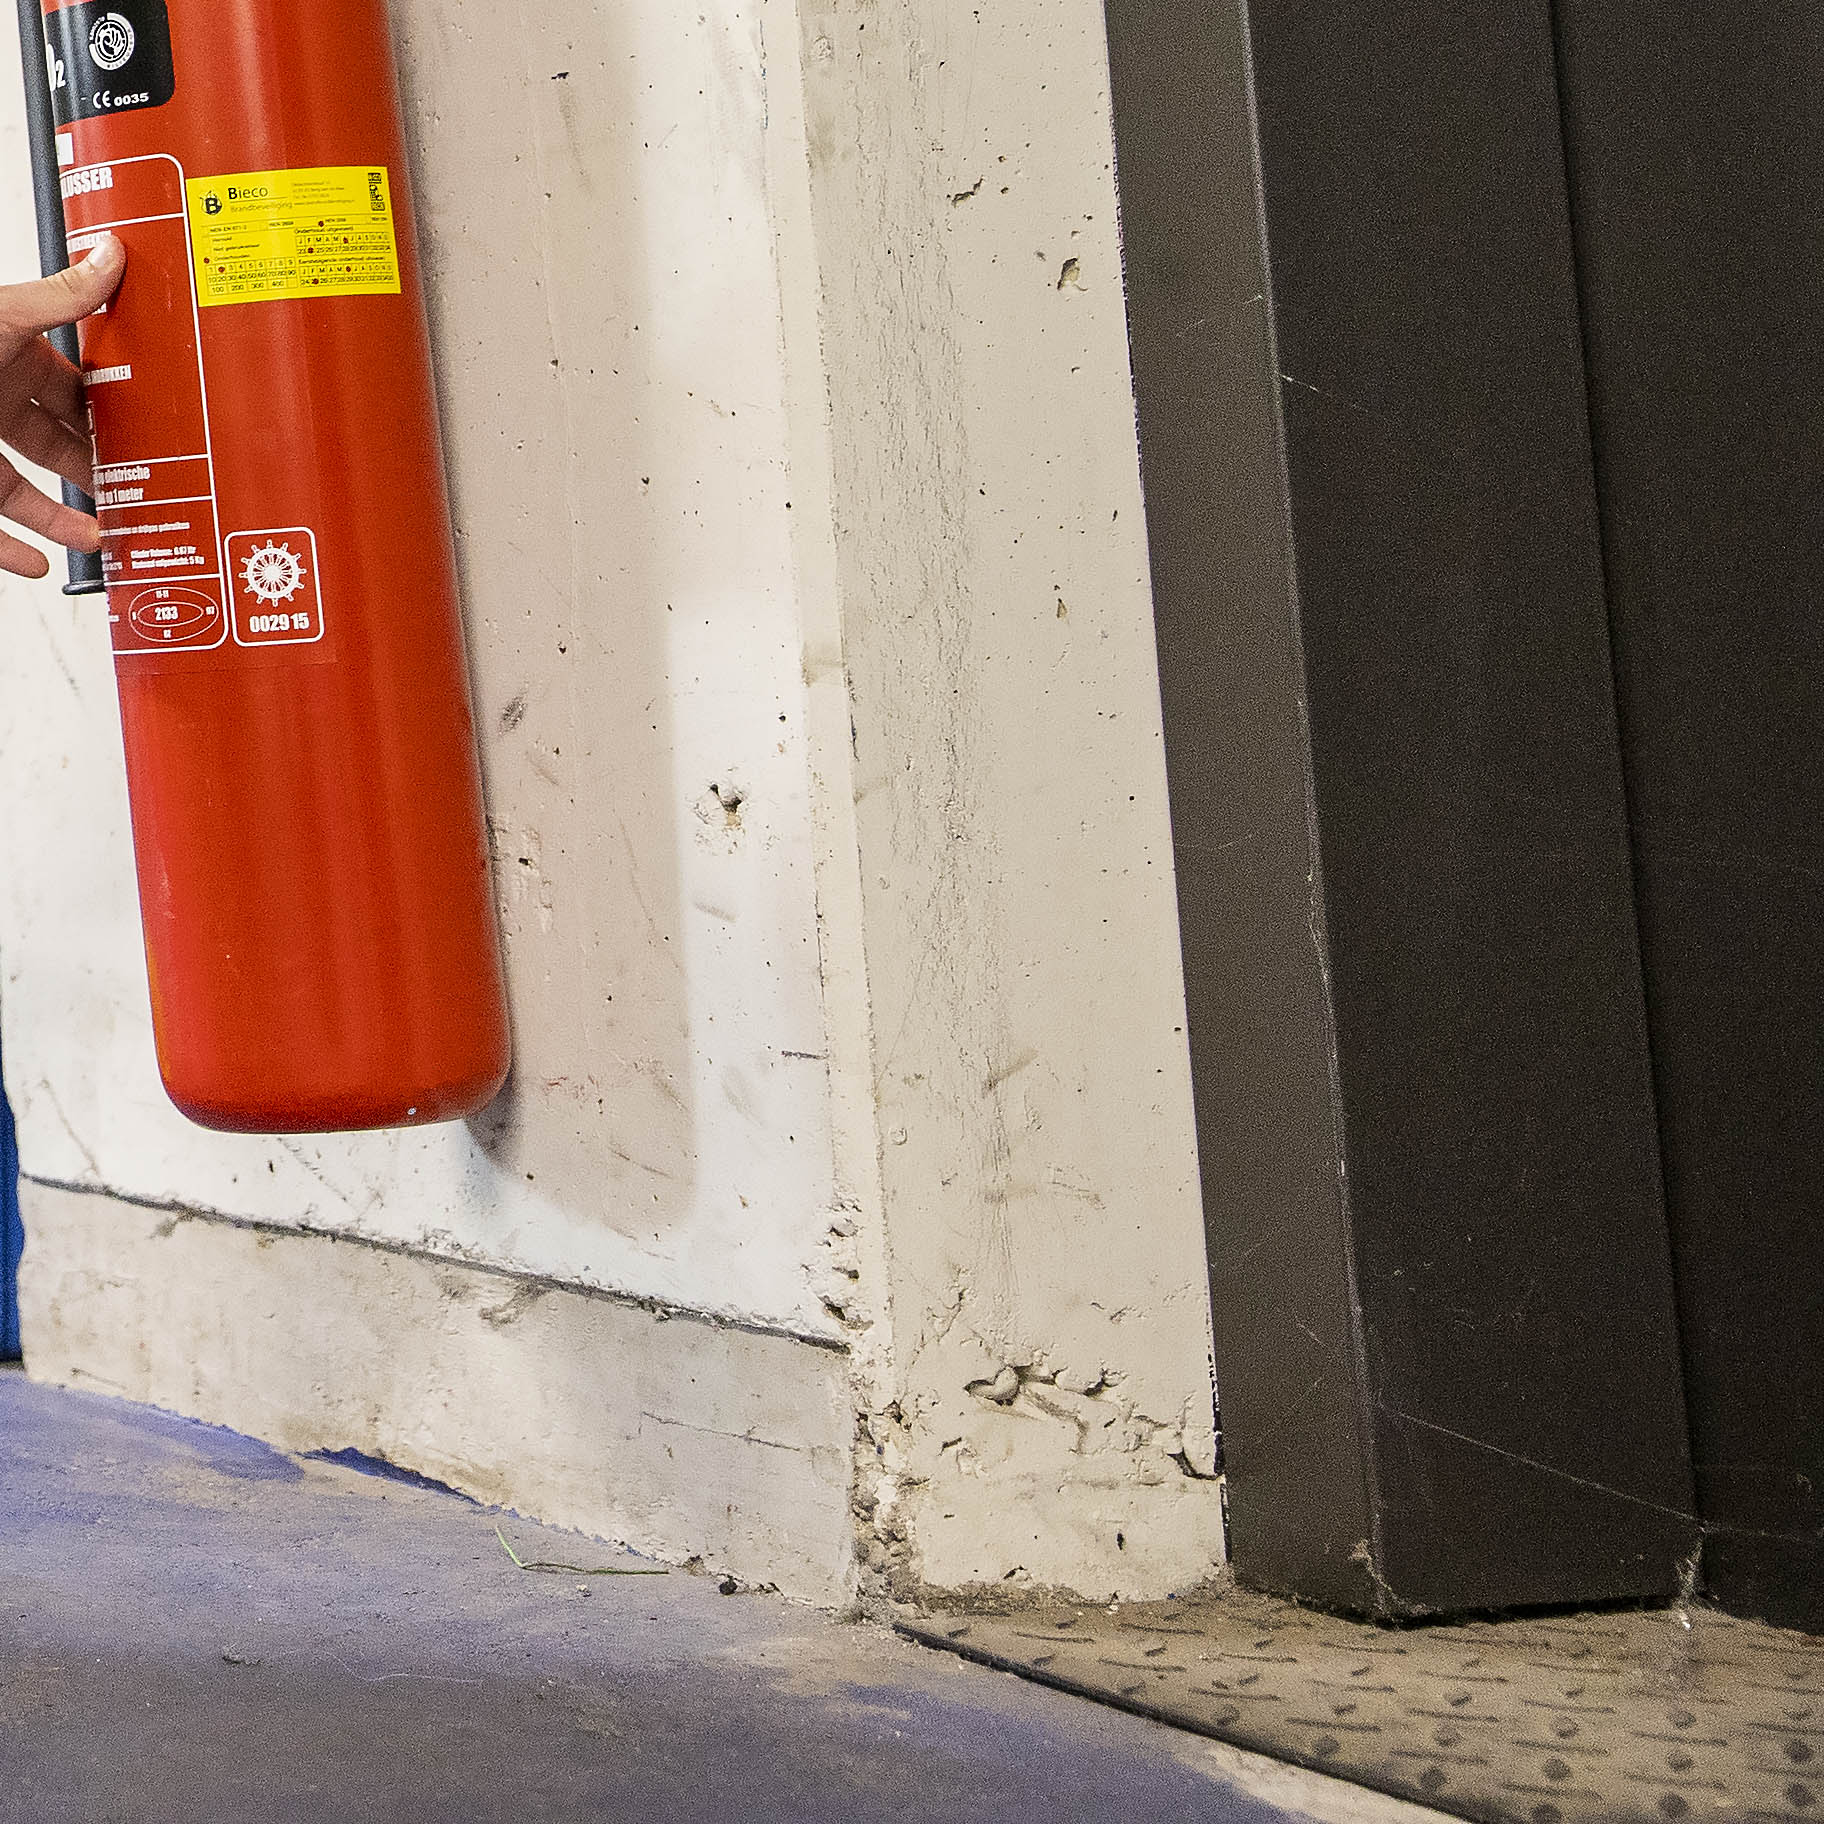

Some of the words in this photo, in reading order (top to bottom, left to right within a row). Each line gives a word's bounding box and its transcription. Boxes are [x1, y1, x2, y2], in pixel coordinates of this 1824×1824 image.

[113, 92, 150, 107] 0035
[228, 186, 268, 199] Bieco
[118, 487, 144, 503] meter
[154, 606, 179, 621] 2133
